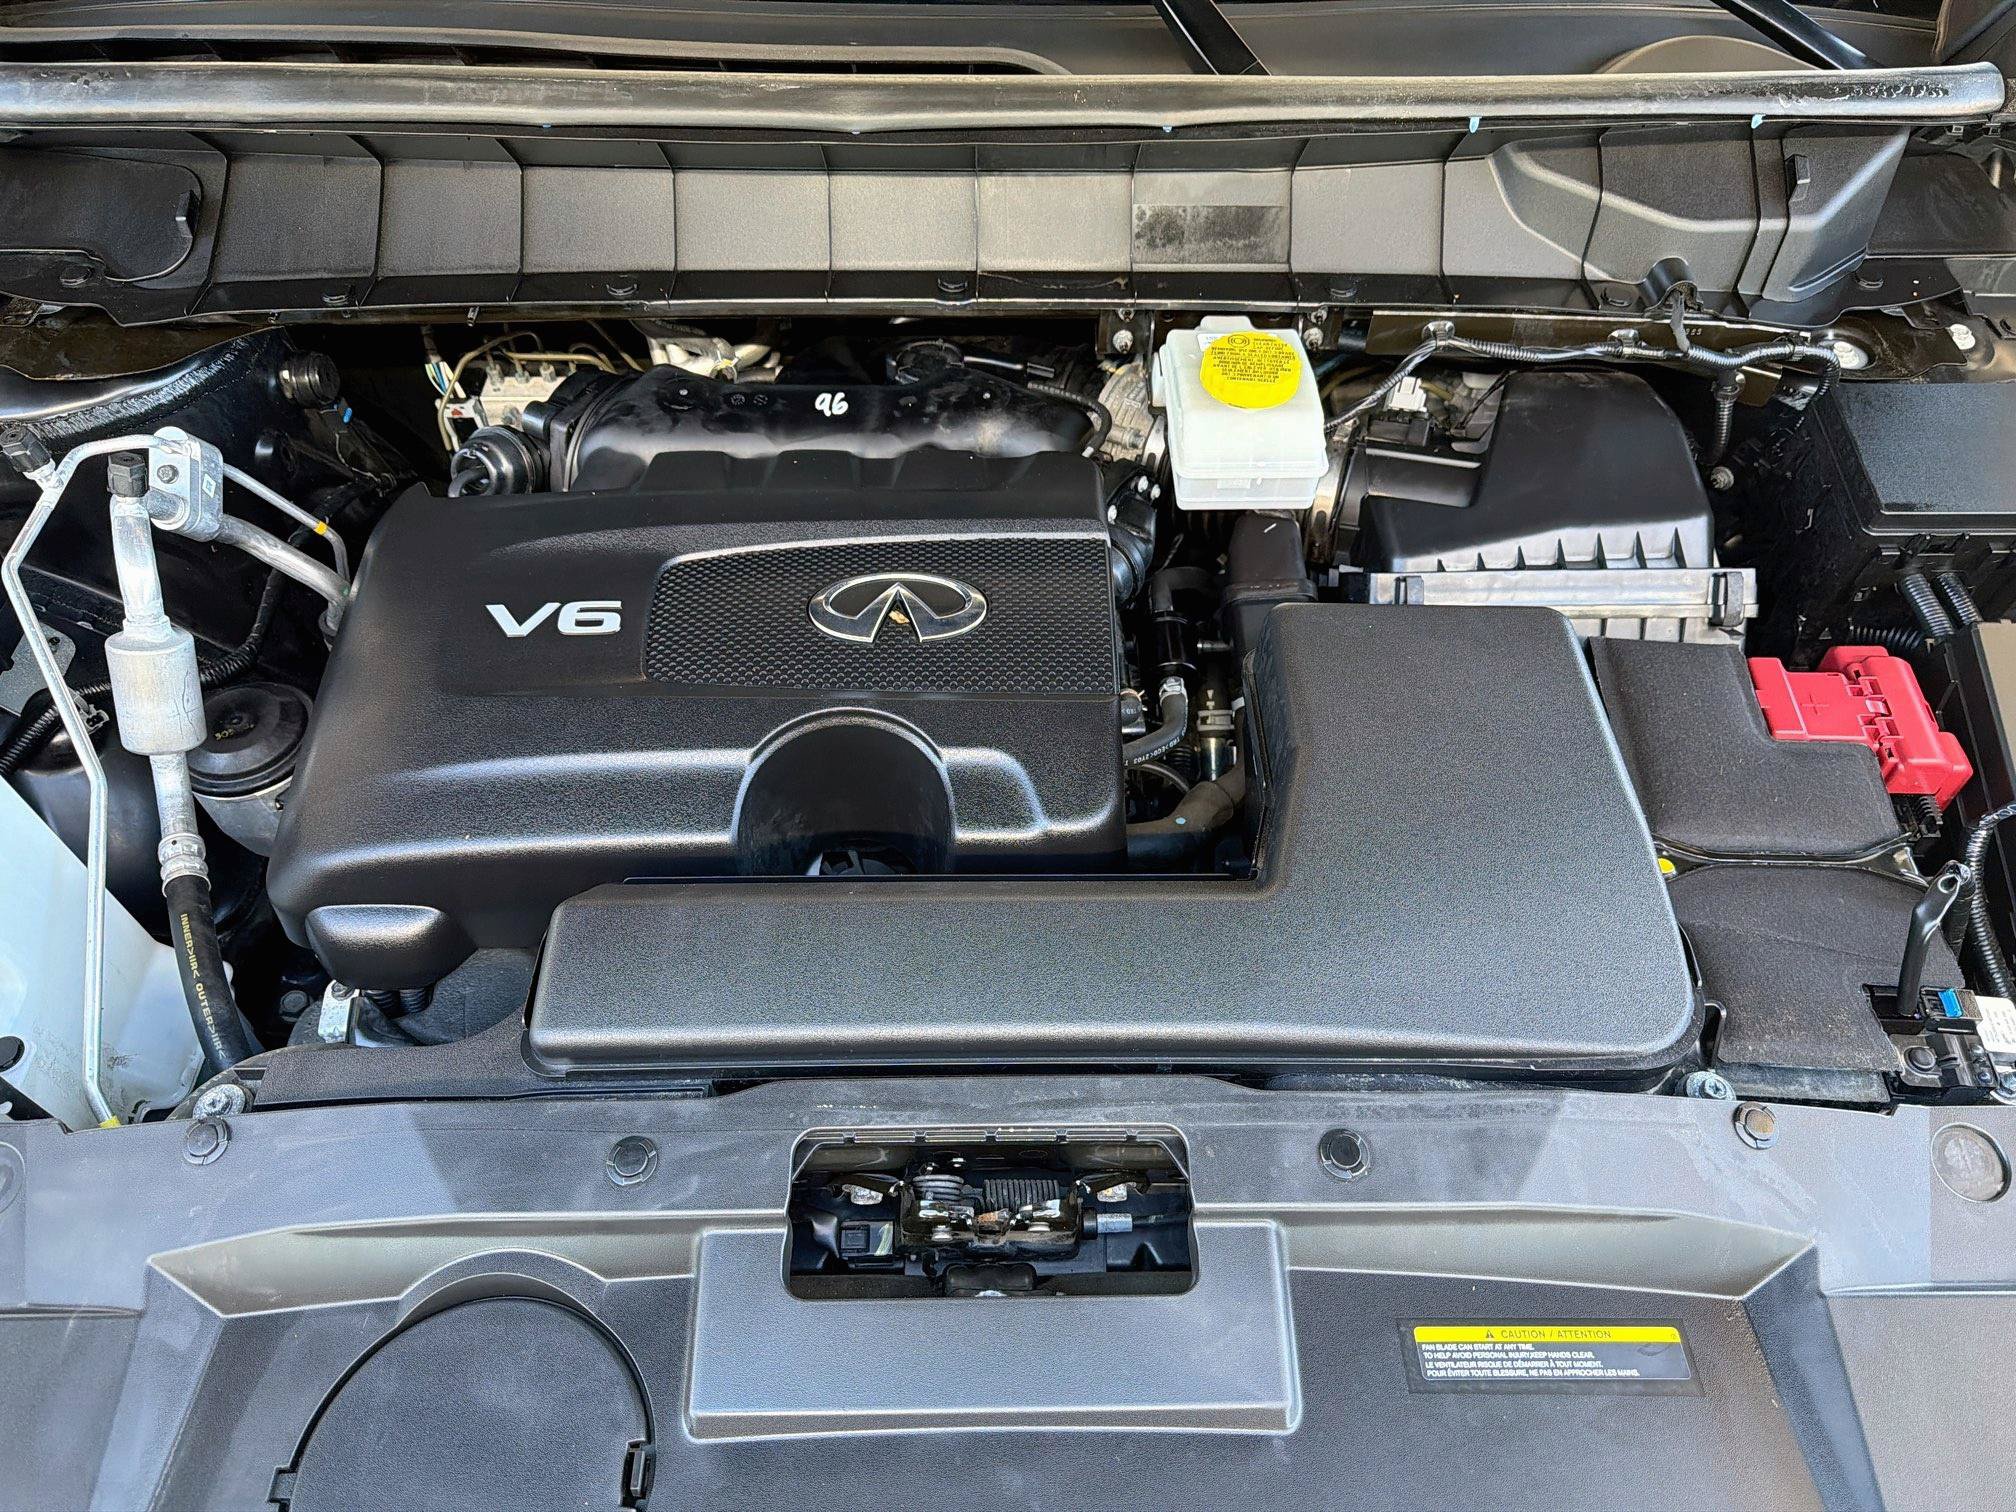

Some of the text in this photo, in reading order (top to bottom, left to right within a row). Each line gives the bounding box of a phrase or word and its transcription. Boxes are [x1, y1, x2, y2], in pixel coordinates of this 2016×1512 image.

[485, 600, 623, 638] V6
[1501, 1329, 1546, 1339] CAUTION
[1557, 1329, 1612, 1339] ATTENTION
[1421, 1343, 1435, 1351] FAN
[1436, 1343, 1458, 1351] BLADE
[1458, 1343, 1473, 1351] CAN
[1473, 1343, 1494, 1351] START
[1423, 1351, 1433, 1359] TO
[1433, 1351, 1451, 1359] HELP
[1451, 1351, 1473, 1359] AVOID
[1472, 1351, 1508, 1359] PERSONAL
[1548, 1351, 1571, 1359] HANDS
[1425, 1361, 1434, 1369] LE
[1434, 1361, 1477, 1369] VENTILATEUR
[1476, 1361, 1503, 1369] RISQUE
[1556, 1360, 1573, 1368] TOUT
[1426, 1369, 1447, 1377] POUR
[1470, 1369, 1492, 1377] TOUTE
[1563, 1368, 1604, 1376] APPROCHER
[1604, 1368, 1617, 1376] LES
